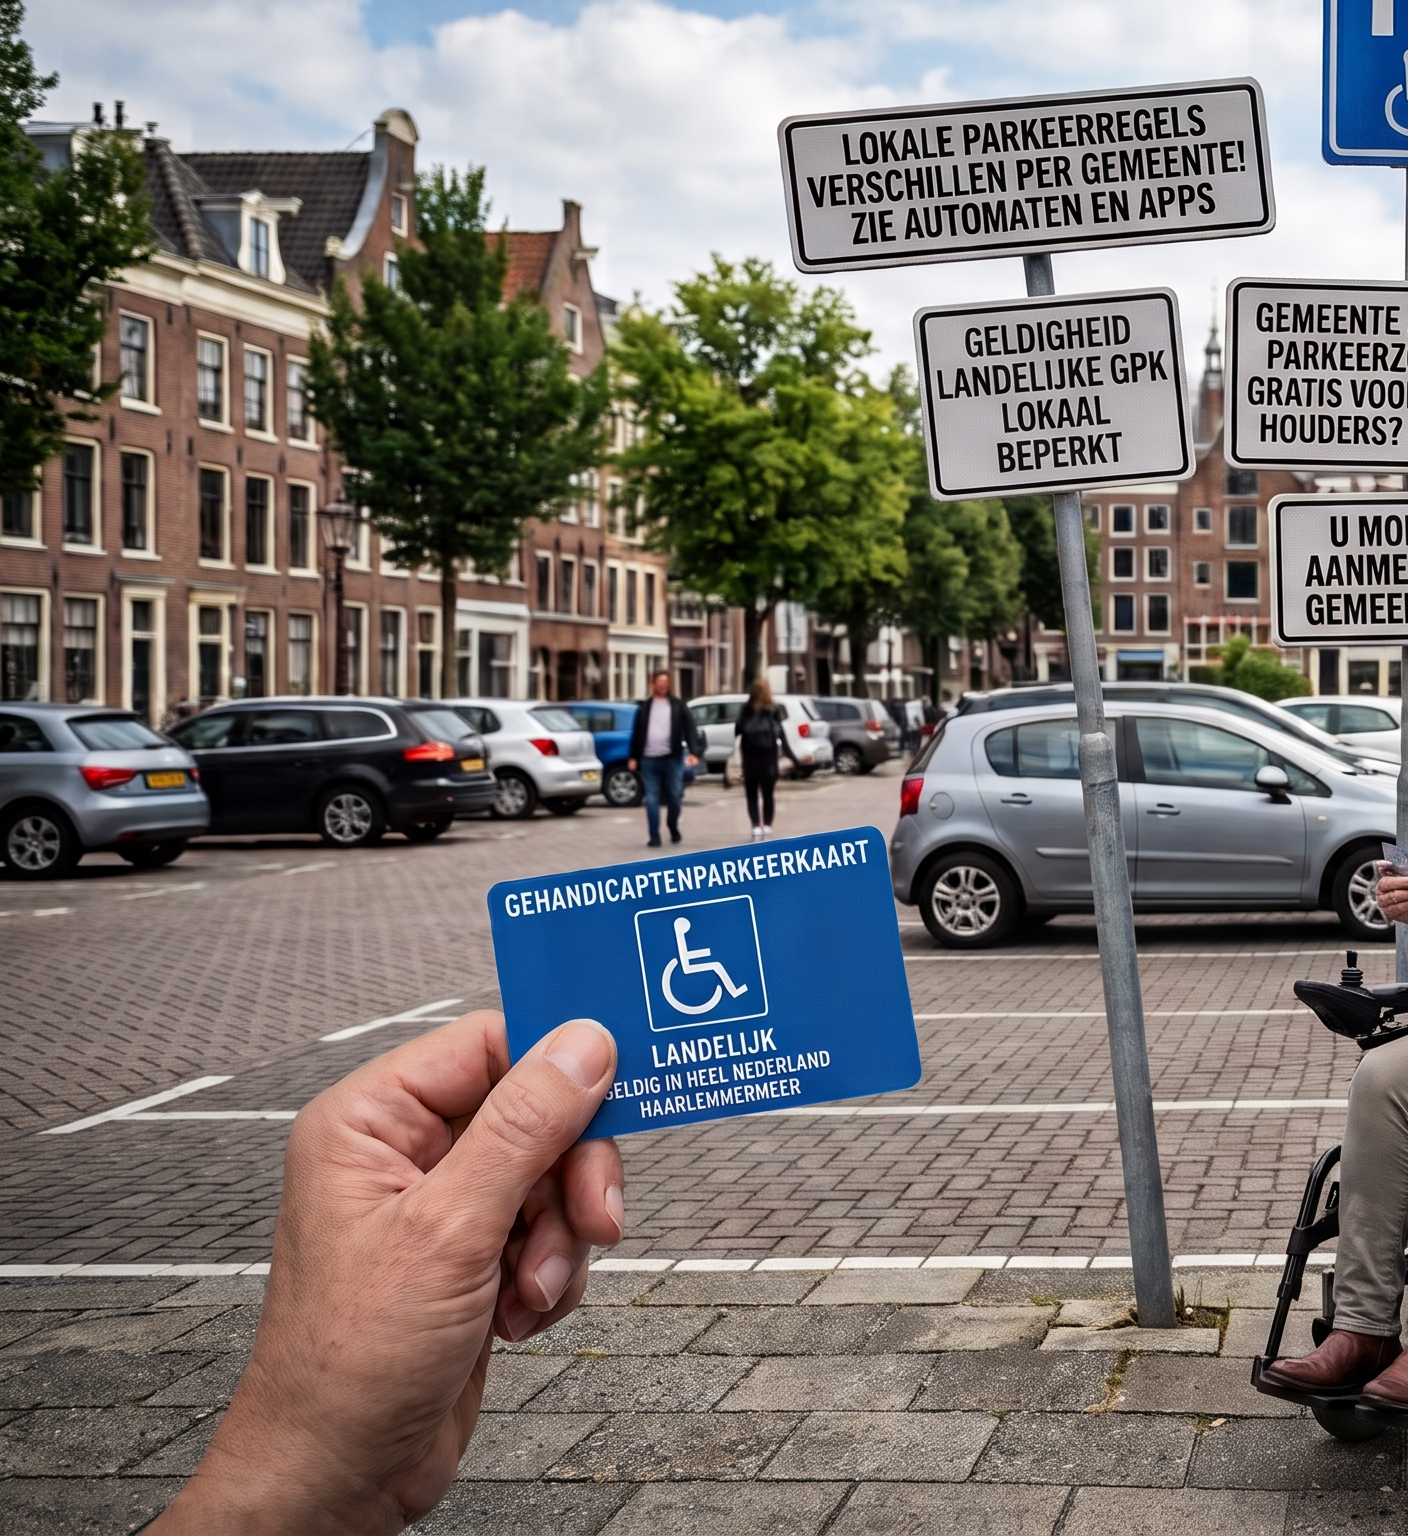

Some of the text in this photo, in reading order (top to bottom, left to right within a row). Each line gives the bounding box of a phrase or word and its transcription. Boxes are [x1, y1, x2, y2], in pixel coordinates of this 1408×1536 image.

[842, 104, 1206, 166] LOKALE PARKEERREGELS
[806, 140, 1246, 208] VERSCHILLEN PER GEMEENTE!
[851, 182, 1216, 245] ZIE AUTOMATEN EN APPS
[965, 315, 1130, 358] GELDIGHEID
[1256, 302, 1401, 335] GEMEENTE
[936, 350, 1168, 400] LANDELIJKE GPK
[1248, 376, 1342, 408] GRATIS
[1002, 395, 1111, 433] LOKAAL
[1260, 413, 1403, 446] HOUDERS?
[996, 432, 1122, 473] BEPERKT
[1330, 516, 1348, 548] U
[505, 839, 868, 918] GEHANDICAPTENPARKEERKAART
[652, 1028, 777, 1068] LANDELIJK
[665, 1073, 682, 1091] IN
[686, 1066, 729, 1088] HEEL
[732, 1050, 830, 1081] NEDERLAND
[640, 1078, 801, 1119] HAARLEMMERMEER
